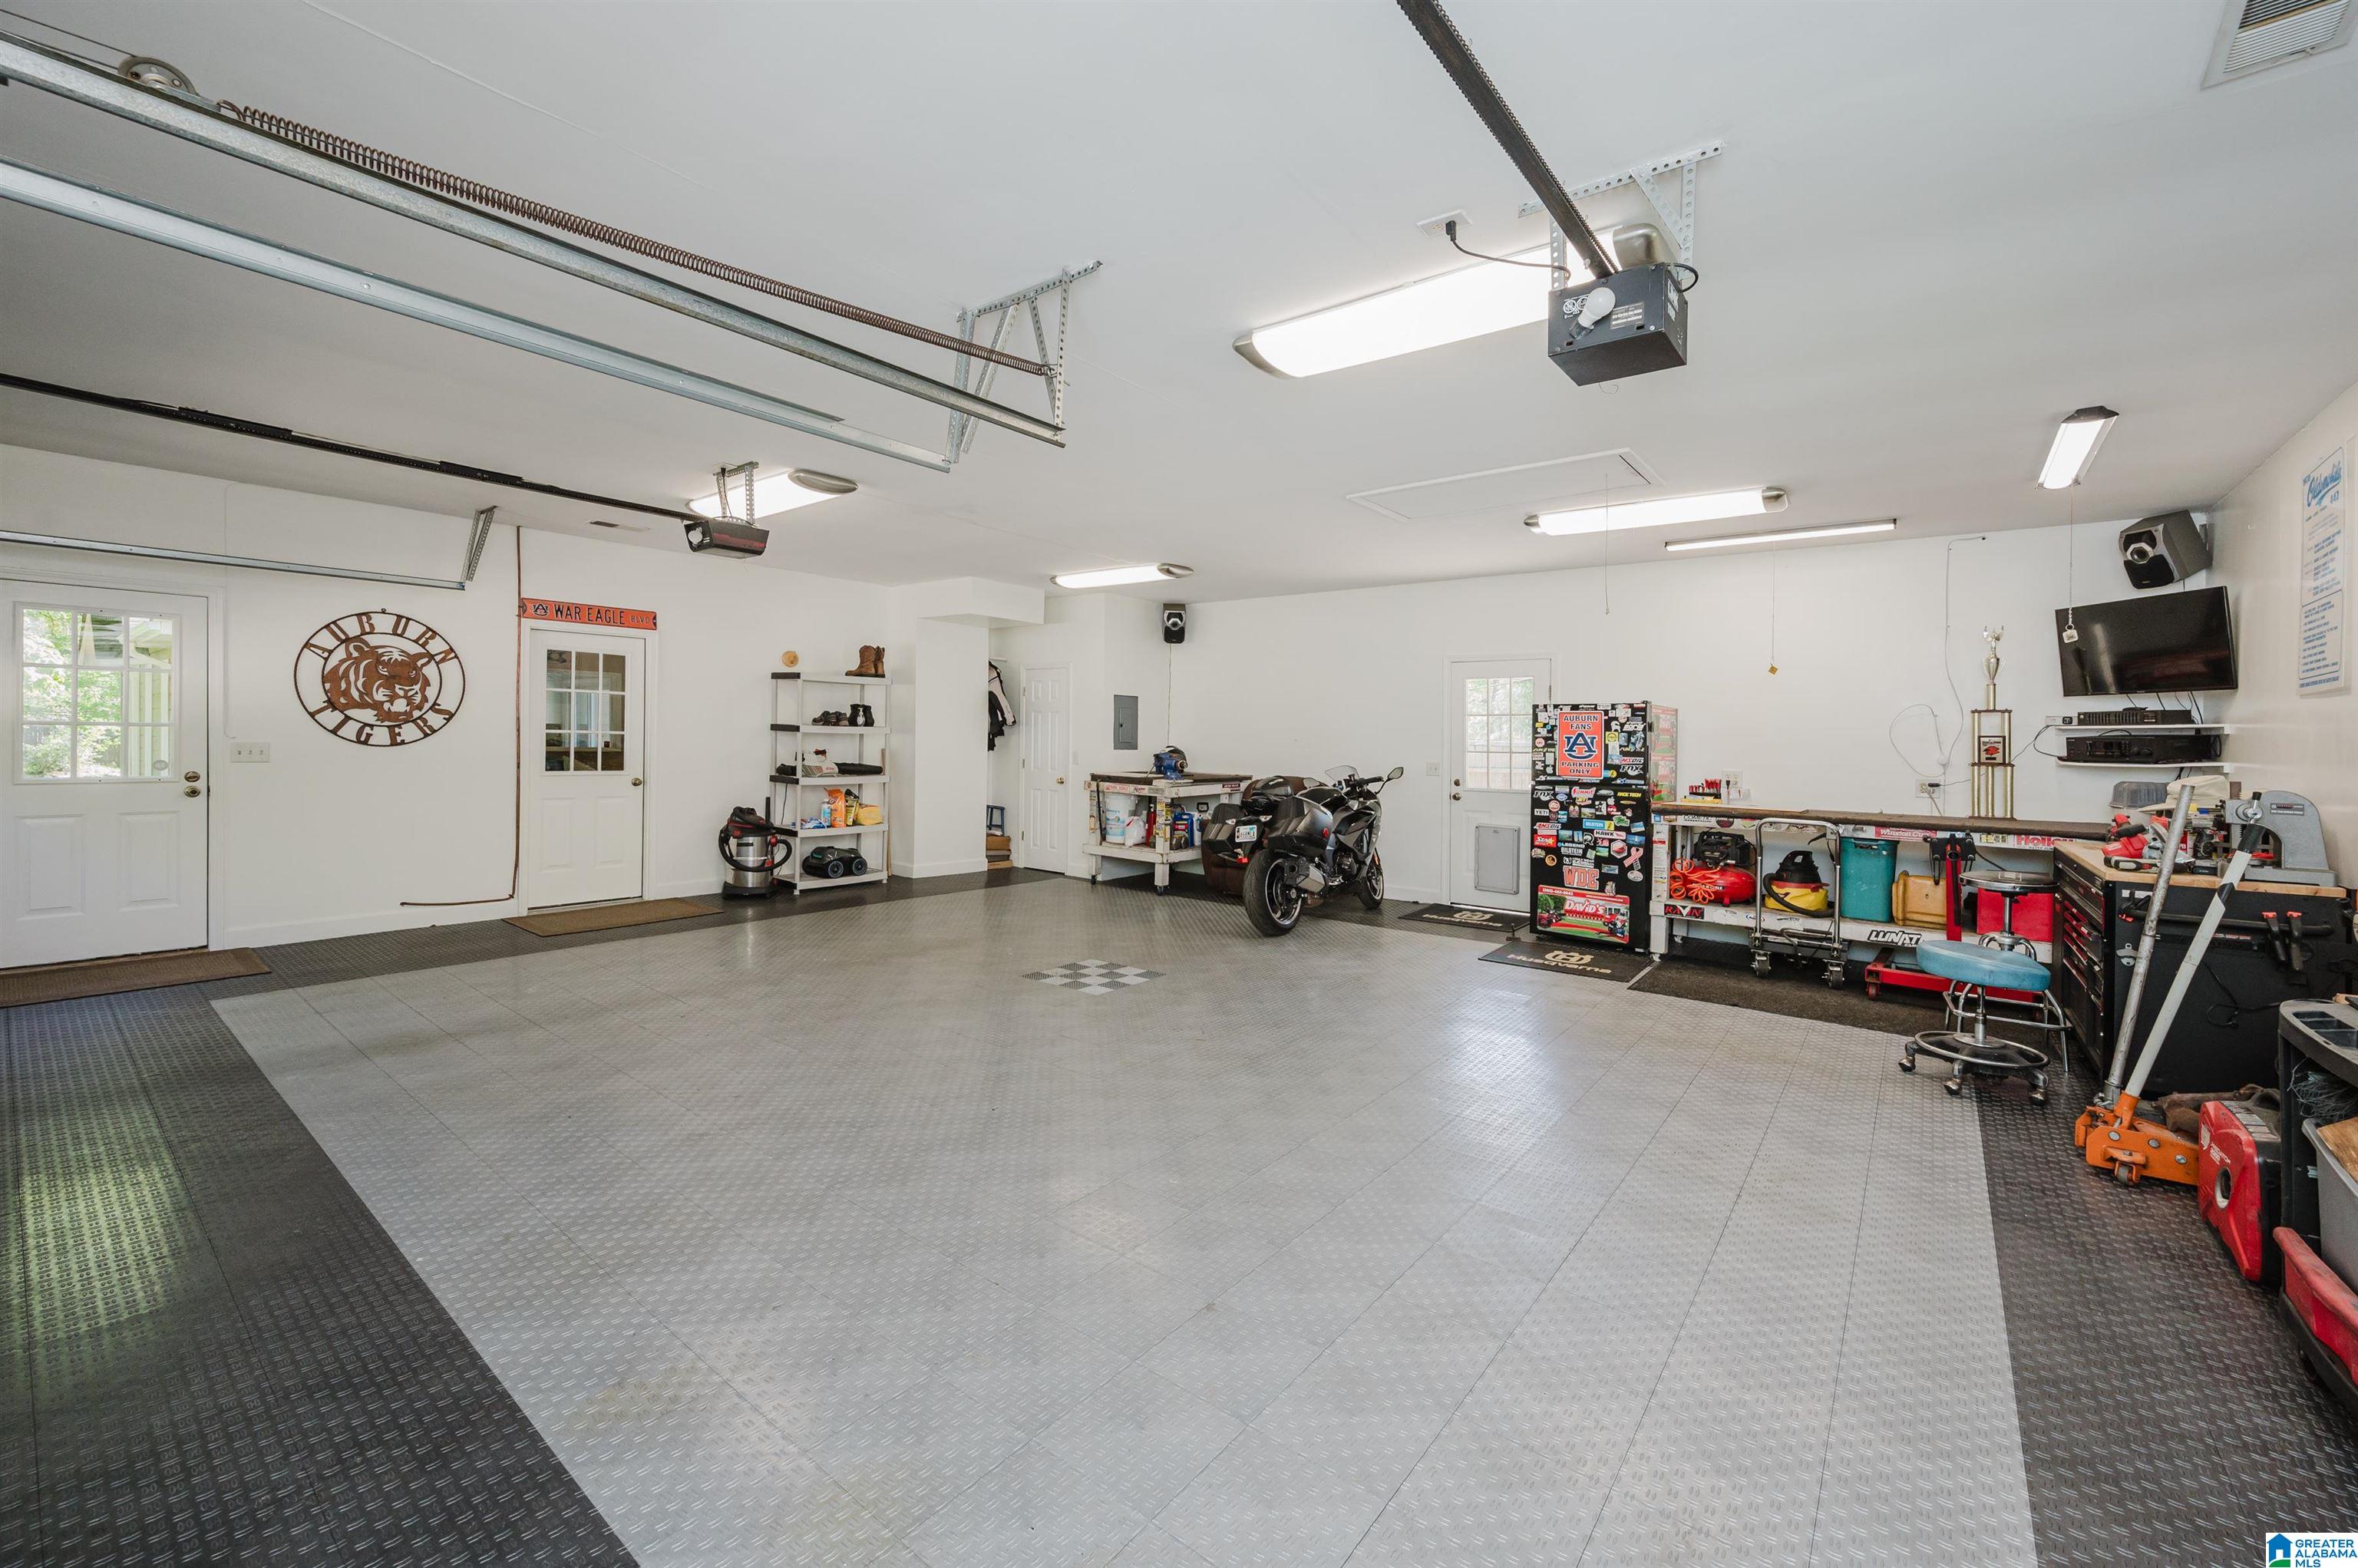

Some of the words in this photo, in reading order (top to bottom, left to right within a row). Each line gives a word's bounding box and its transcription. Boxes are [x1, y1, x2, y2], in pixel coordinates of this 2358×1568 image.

[553, 602, 582, 621] WAR
[586, 607, 626, 625] EAGLE
[629, 615, 650, 624] BLVD
[305, 614, 459, 665] AUBURN
[309, 699, 453, 745] TIGERS
[1534, 790, 1554, 799] FOX
[1564, 867, 1599, 889] WDE
[1422, 913, 1503, 927] Husqvarna
[1507, 954, 1612, 974] Husqvarna
